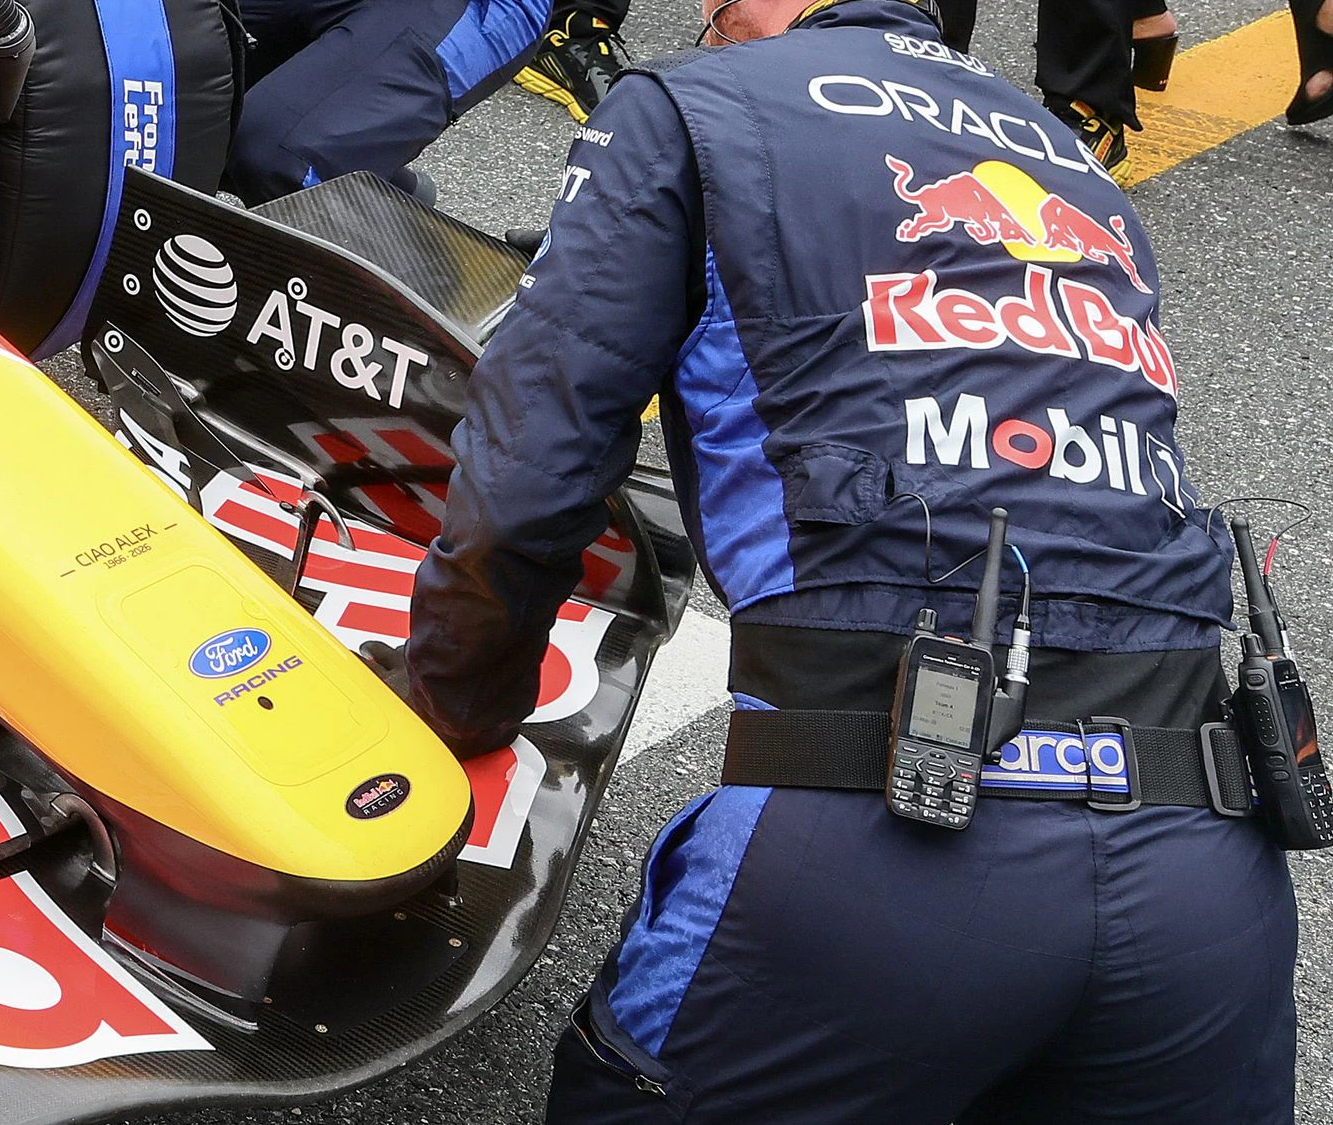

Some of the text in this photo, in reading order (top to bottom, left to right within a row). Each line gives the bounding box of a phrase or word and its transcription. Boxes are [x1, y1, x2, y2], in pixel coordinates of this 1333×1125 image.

[121, 78, 142, 168] Left
[141, 79, 165, 171] Fron
[575, 126, 614, 148] sword
[863, 262, 1081, 361] Red
[246, 288, 430, 410] AT&T
[905, 392, 1146, 496] Mobil
[74, 523, 159, 569] CIAO ALEX
[102, 543, 153, 570] 1966 2026
[204, 635, 259, 673] Ford
[213, 655, 304, 707] RACING
[997, 733, 1127, 775] arco
[363, 789, 404, 816] RACING
